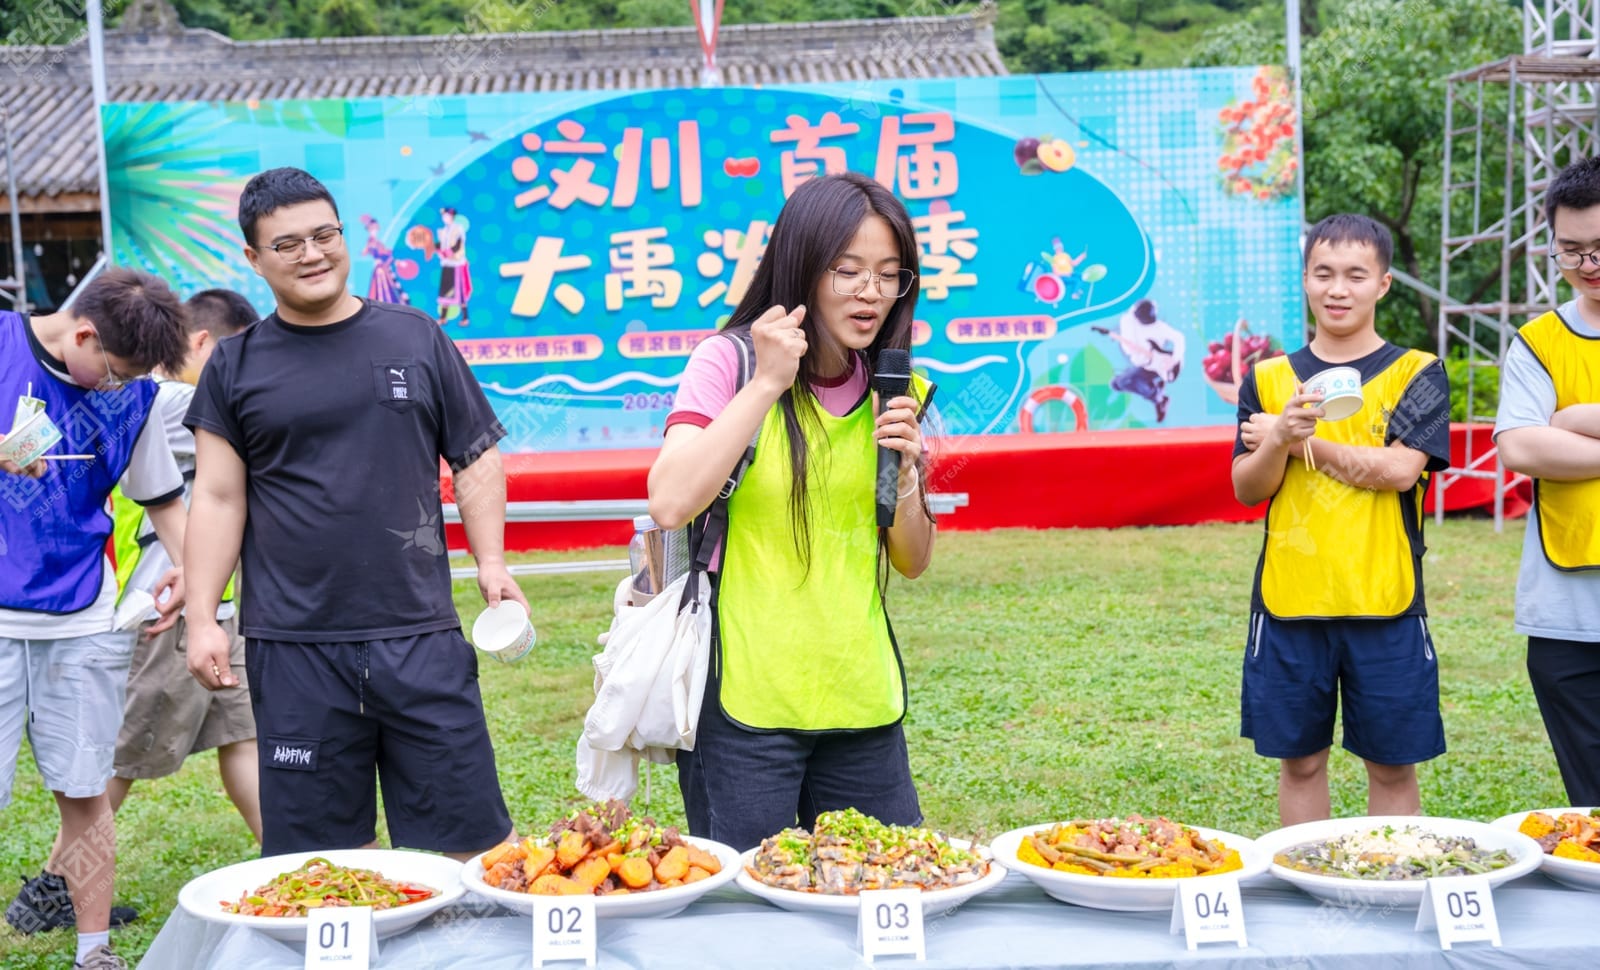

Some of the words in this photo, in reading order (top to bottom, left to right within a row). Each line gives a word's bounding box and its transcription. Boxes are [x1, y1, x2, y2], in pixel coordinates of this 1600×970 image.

[512, 119, 702, 210] 汶川
[770, 112, 959, 200] 首届
[630, 334, 712, 352] 摇滚音乐
[624, 393, 674, 411] 2024
[876, 902, 910, 930] 03
[1195, 891, 1230, 919] 04
[1447, 890, 1481, 918] 05
[548, 907, 582, 934] 02
[319, 920, 350, 950] 01
